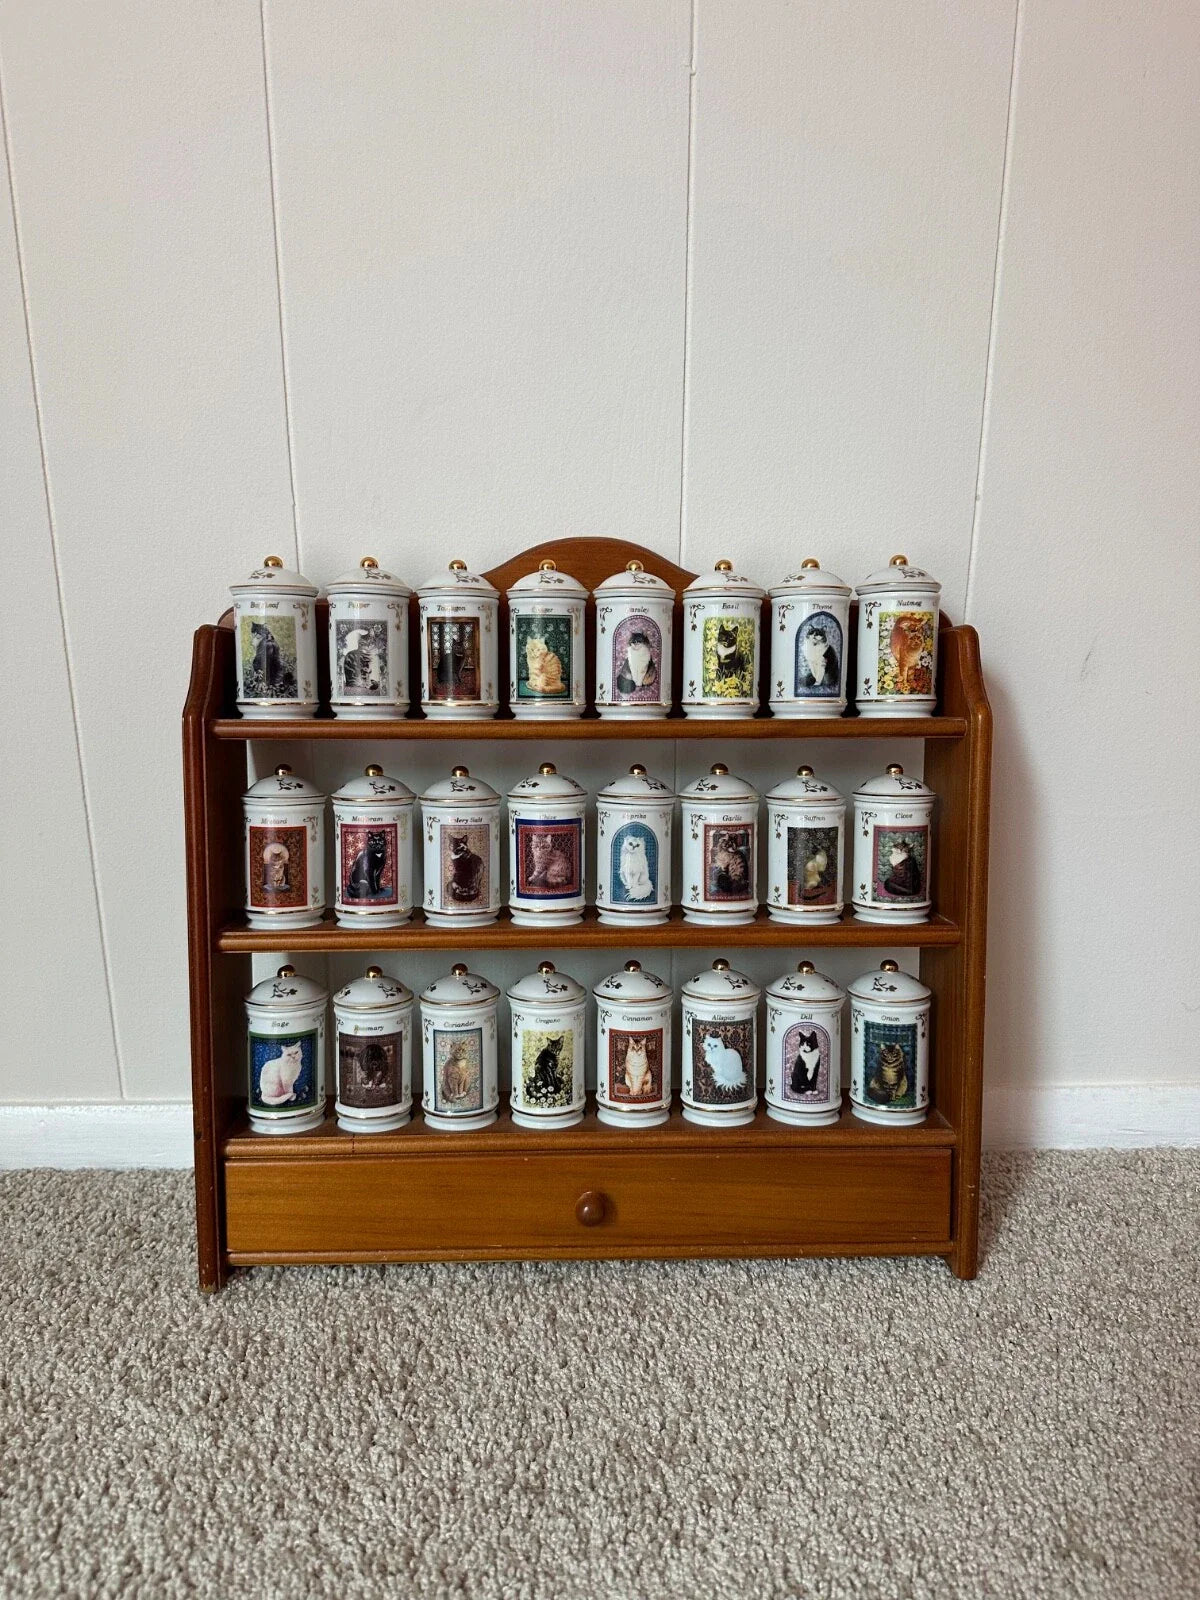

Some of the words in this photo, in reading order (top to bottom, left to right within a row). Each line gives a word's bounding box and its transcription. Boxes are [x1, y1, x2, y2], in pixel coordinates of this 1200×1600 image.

[896, 599, 922, 607] Nutmeg
[436, 604, 466, 612] Taagon
[627, 605, 649, 614] arsley
[352, 815, 383, 823] Maoram
[449, 816, 469, 824] lery
[803, 814, 826, 822] Saffron
[535, 1017, 560, 1025] Oregano
[881, 1014, 900, 1022] Onion
